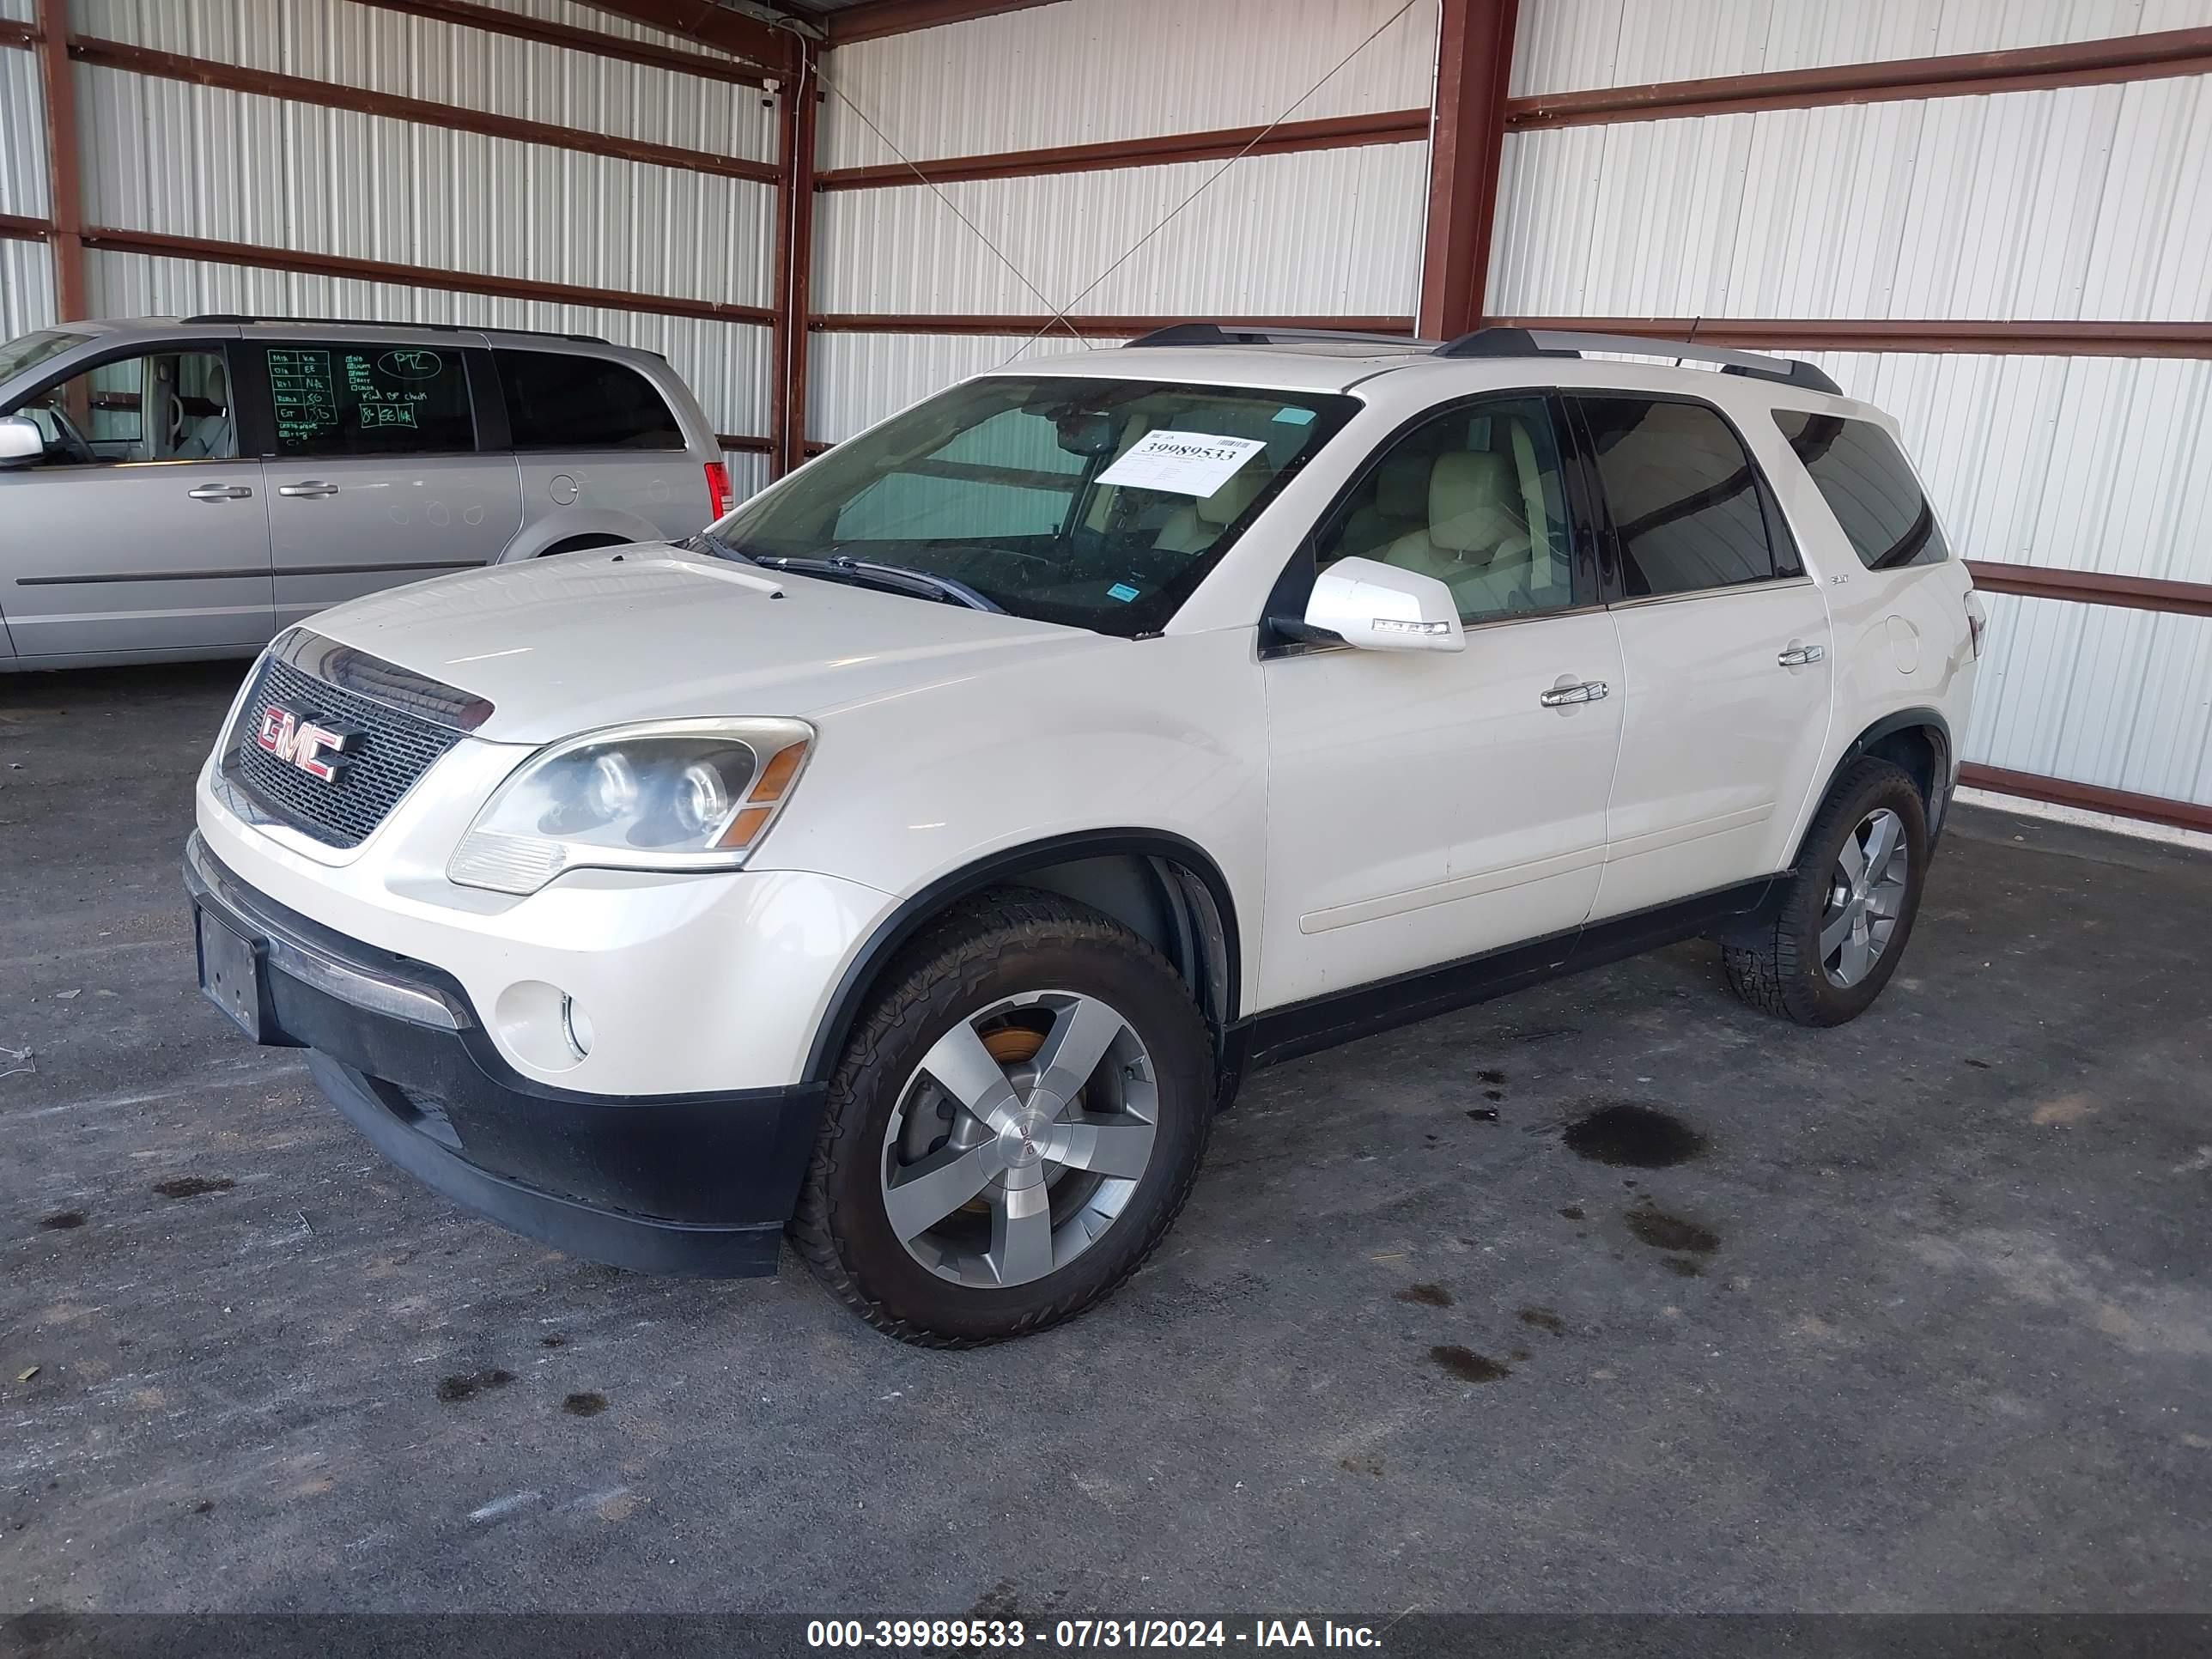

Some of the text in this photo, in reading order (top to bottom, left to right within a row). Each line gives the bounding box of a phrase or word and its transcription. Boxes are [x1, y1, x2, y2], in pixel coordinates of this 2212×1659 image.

[1141, 442, 1237, 461] 39989533
[258, 705, 344, 783] GMC
[1019, 1124, 1035, 1155] GMC
